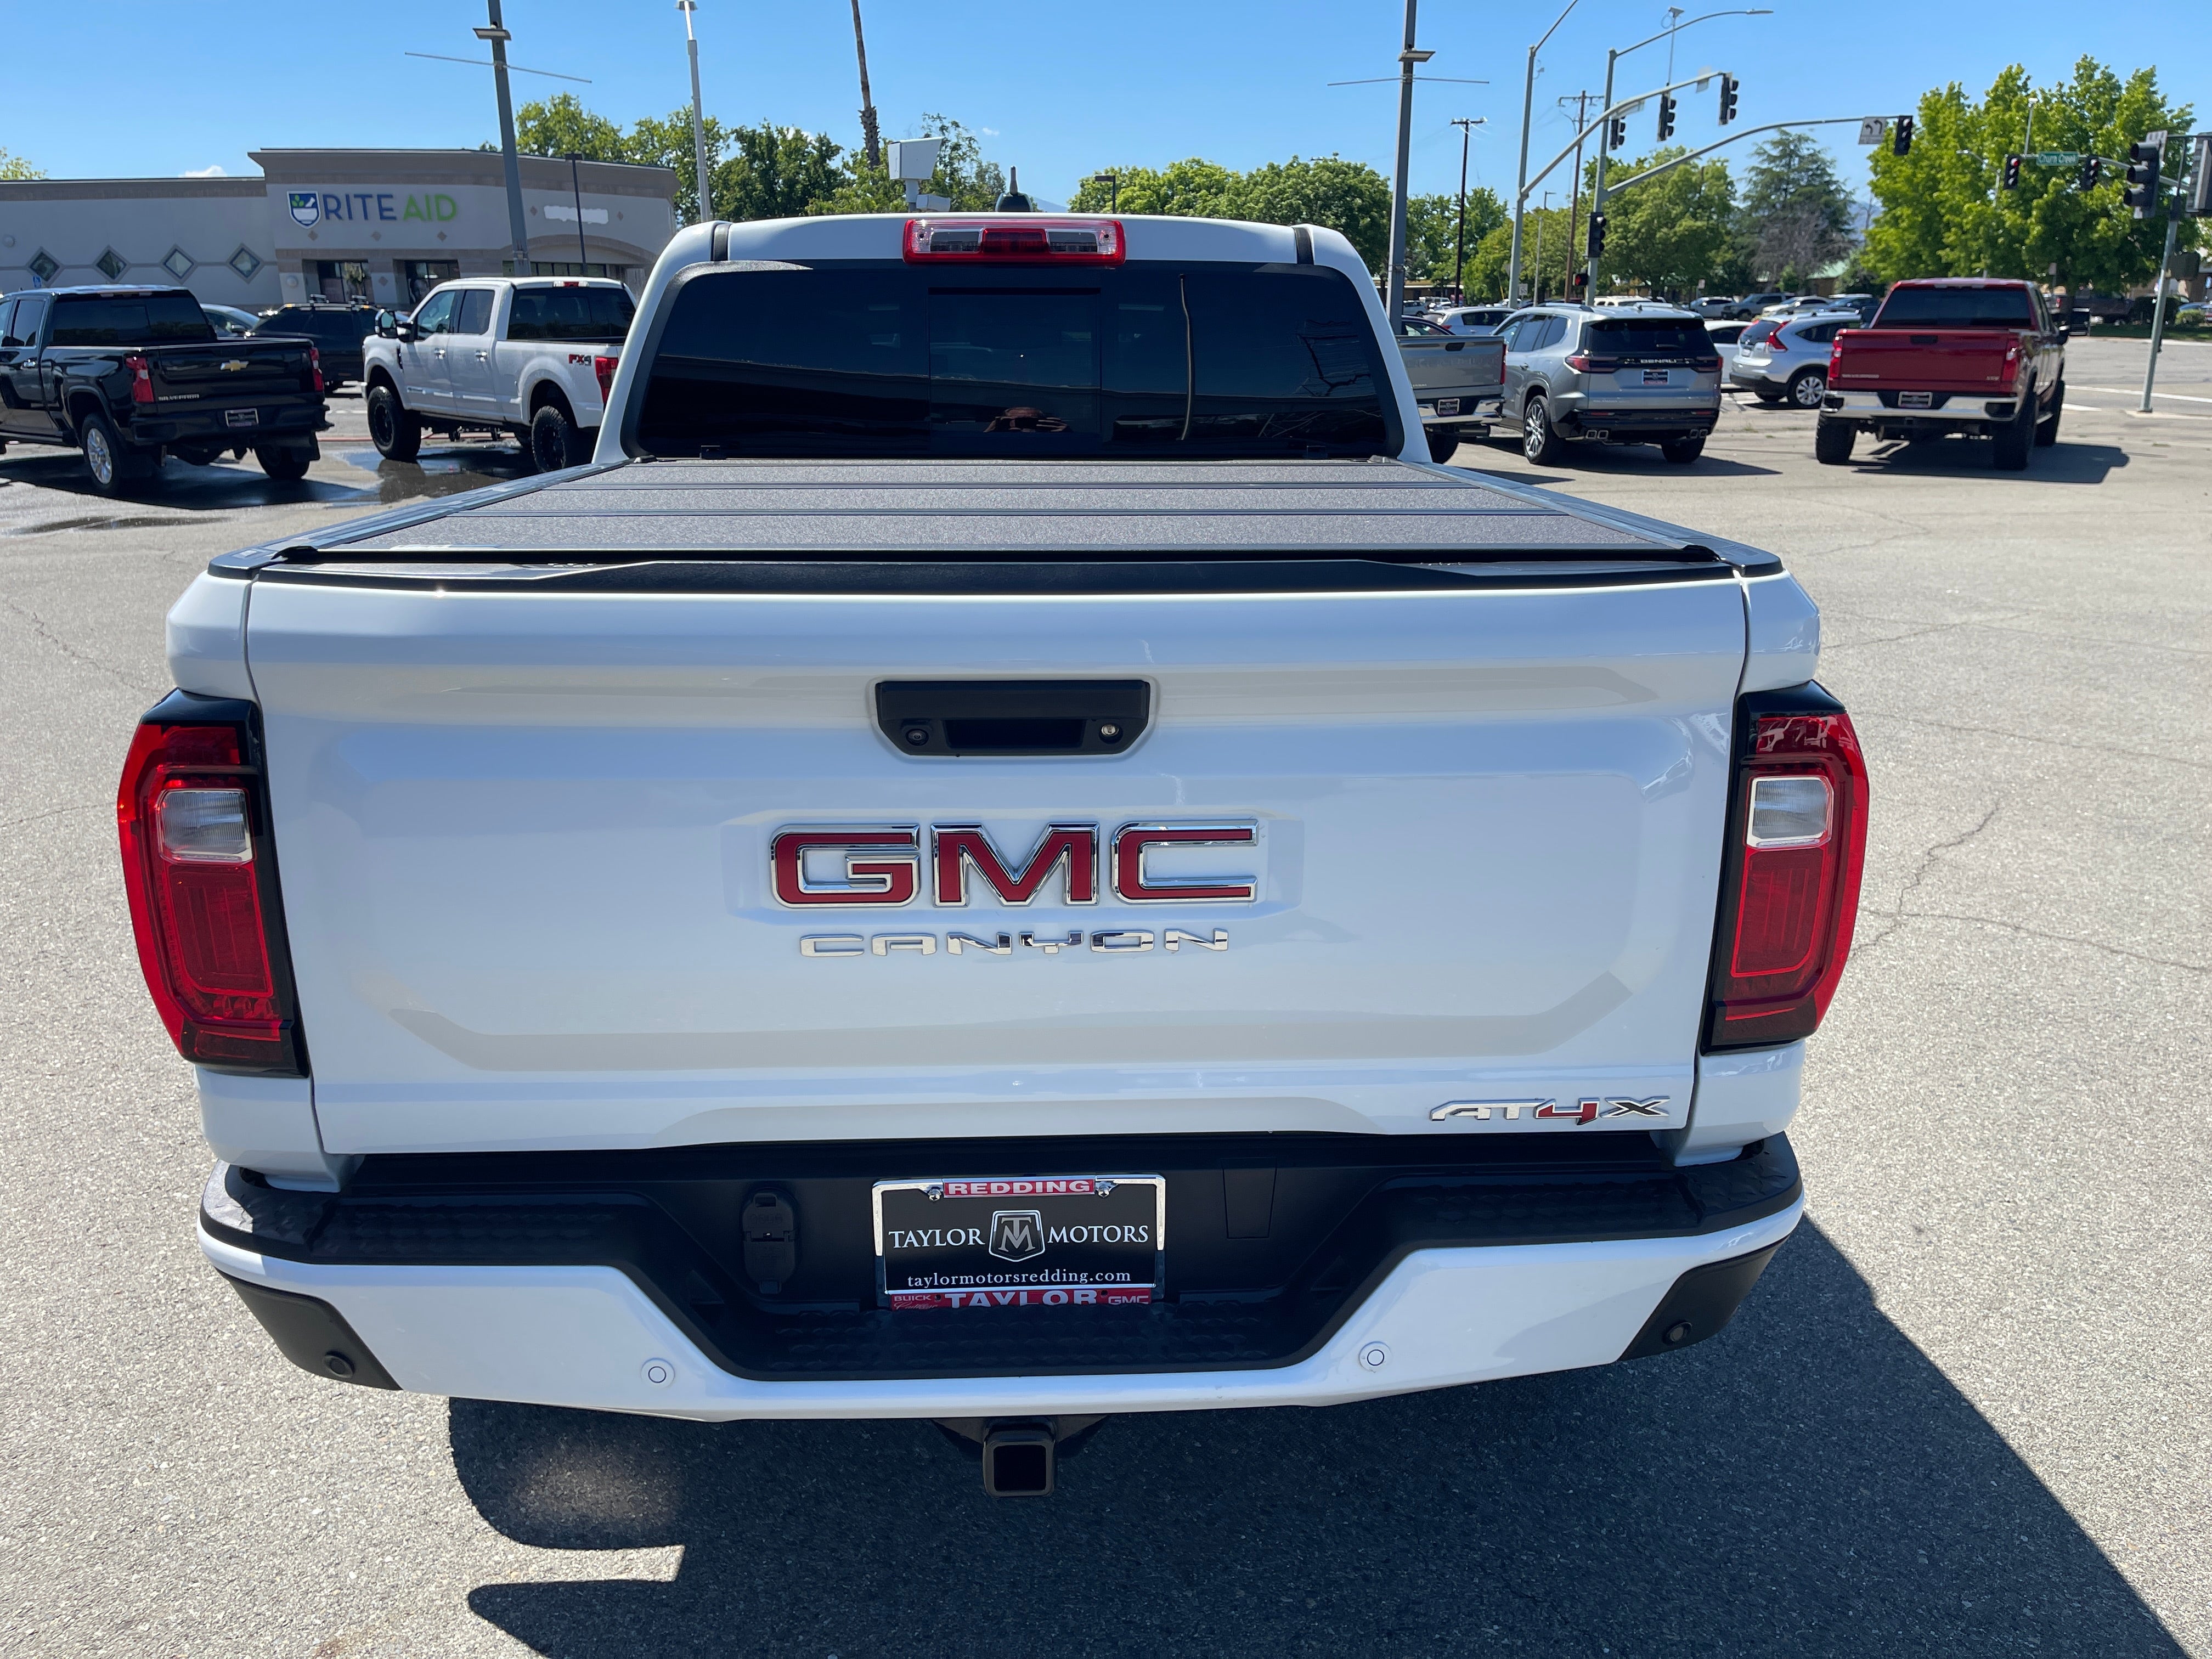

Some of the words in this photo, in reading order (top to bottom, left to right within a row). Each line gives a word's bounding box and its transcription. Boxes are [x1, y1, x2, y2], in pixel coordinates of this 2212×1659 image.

[323, 194, 397, 221] RITE
[403, 193, 457, 222] AID
[568, 354, 591, 366] FX4
[770, 821, 1259, 907] GMC
[800, 928, 1228, 957] CANYON
[1430, 1096, 1670, 1125] AT4X
[949, 1180, 1090, 1194] REDDING
[888, 1228, 985, 1248] TAYLOR
[1047, 1225, 1149, 1243] MOTORS
[907, 1269, 1131, 1289] taylormotorsredding.com
[944, 1290, 1097, 1308] TAYLOR
[1108, 1295, 1149, 1305] GMC
